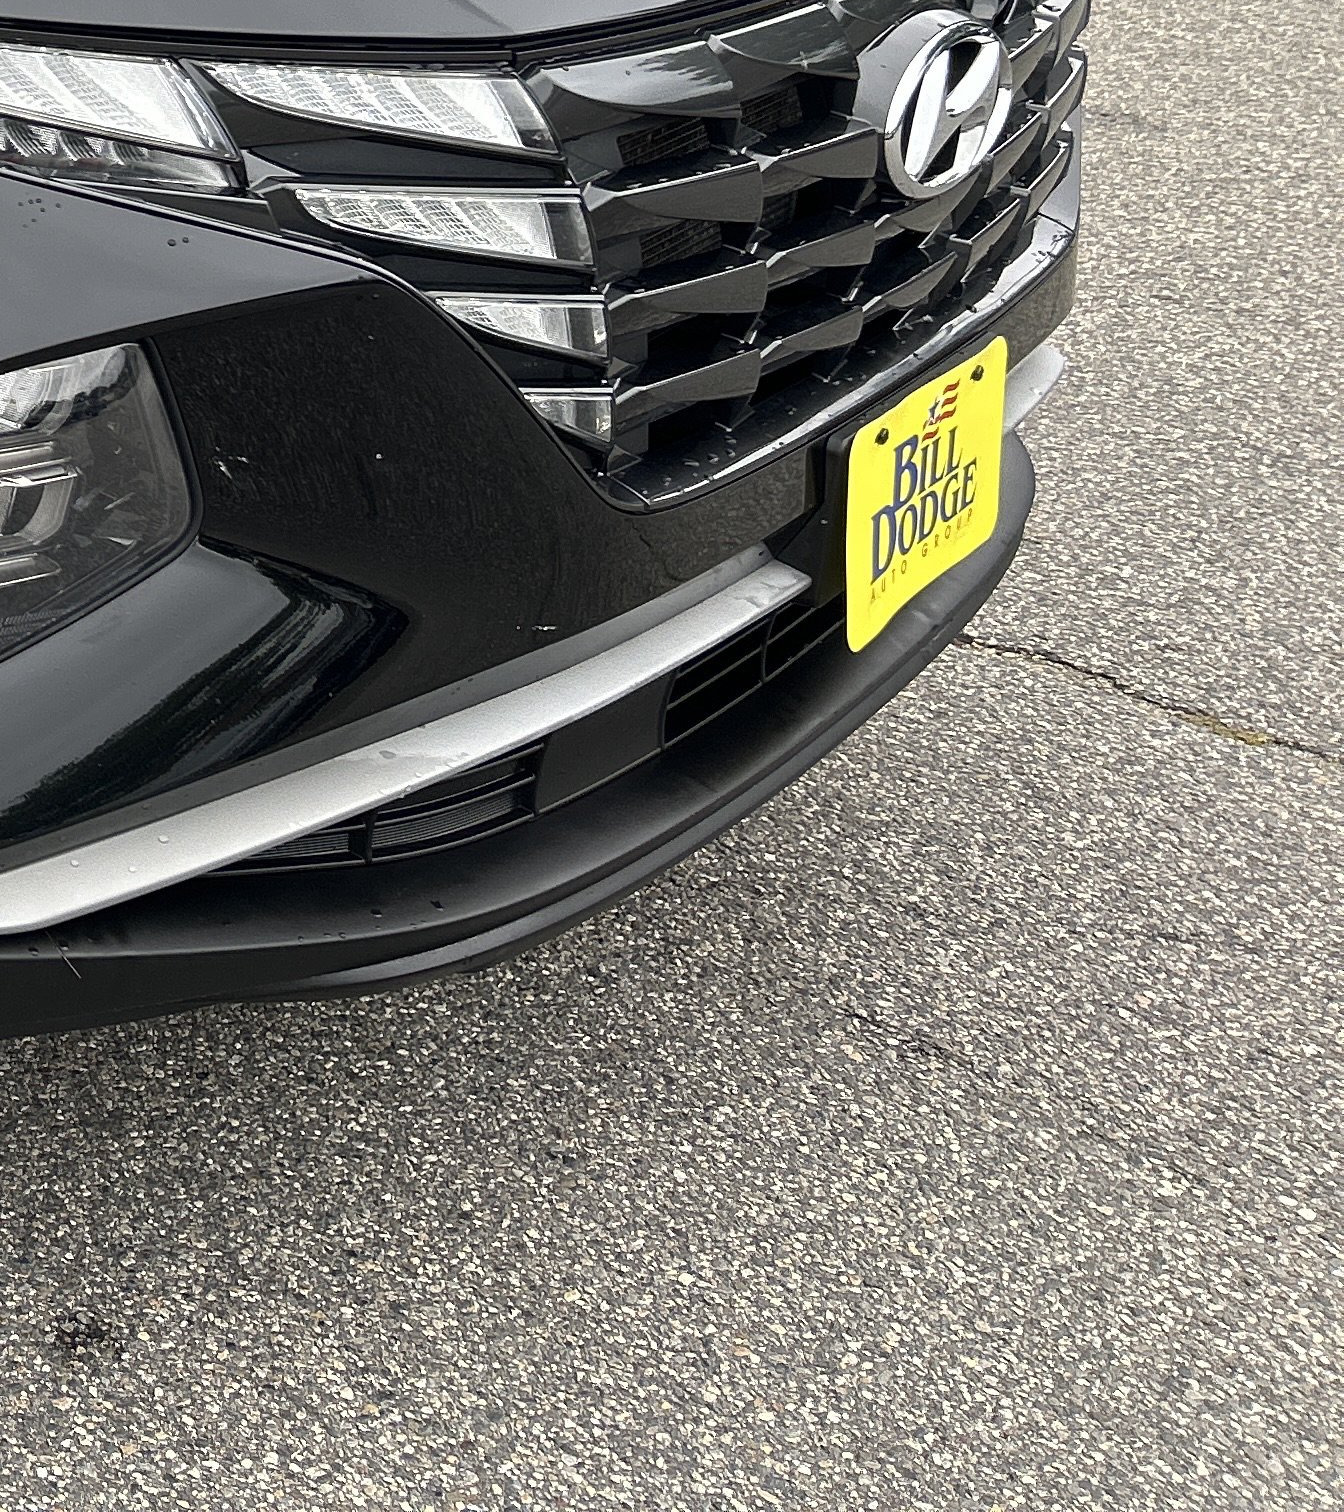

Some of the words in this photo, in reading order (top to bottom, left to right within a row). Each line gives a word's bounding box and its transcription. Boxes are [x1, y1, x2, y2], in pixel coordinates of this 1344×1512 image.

[893, 424, 964, 509] BILL
[869, 559, 908, 602] AUTO
[920, 507, 975, 559] GROUP
[870, 457, 978, 586] DODGE
